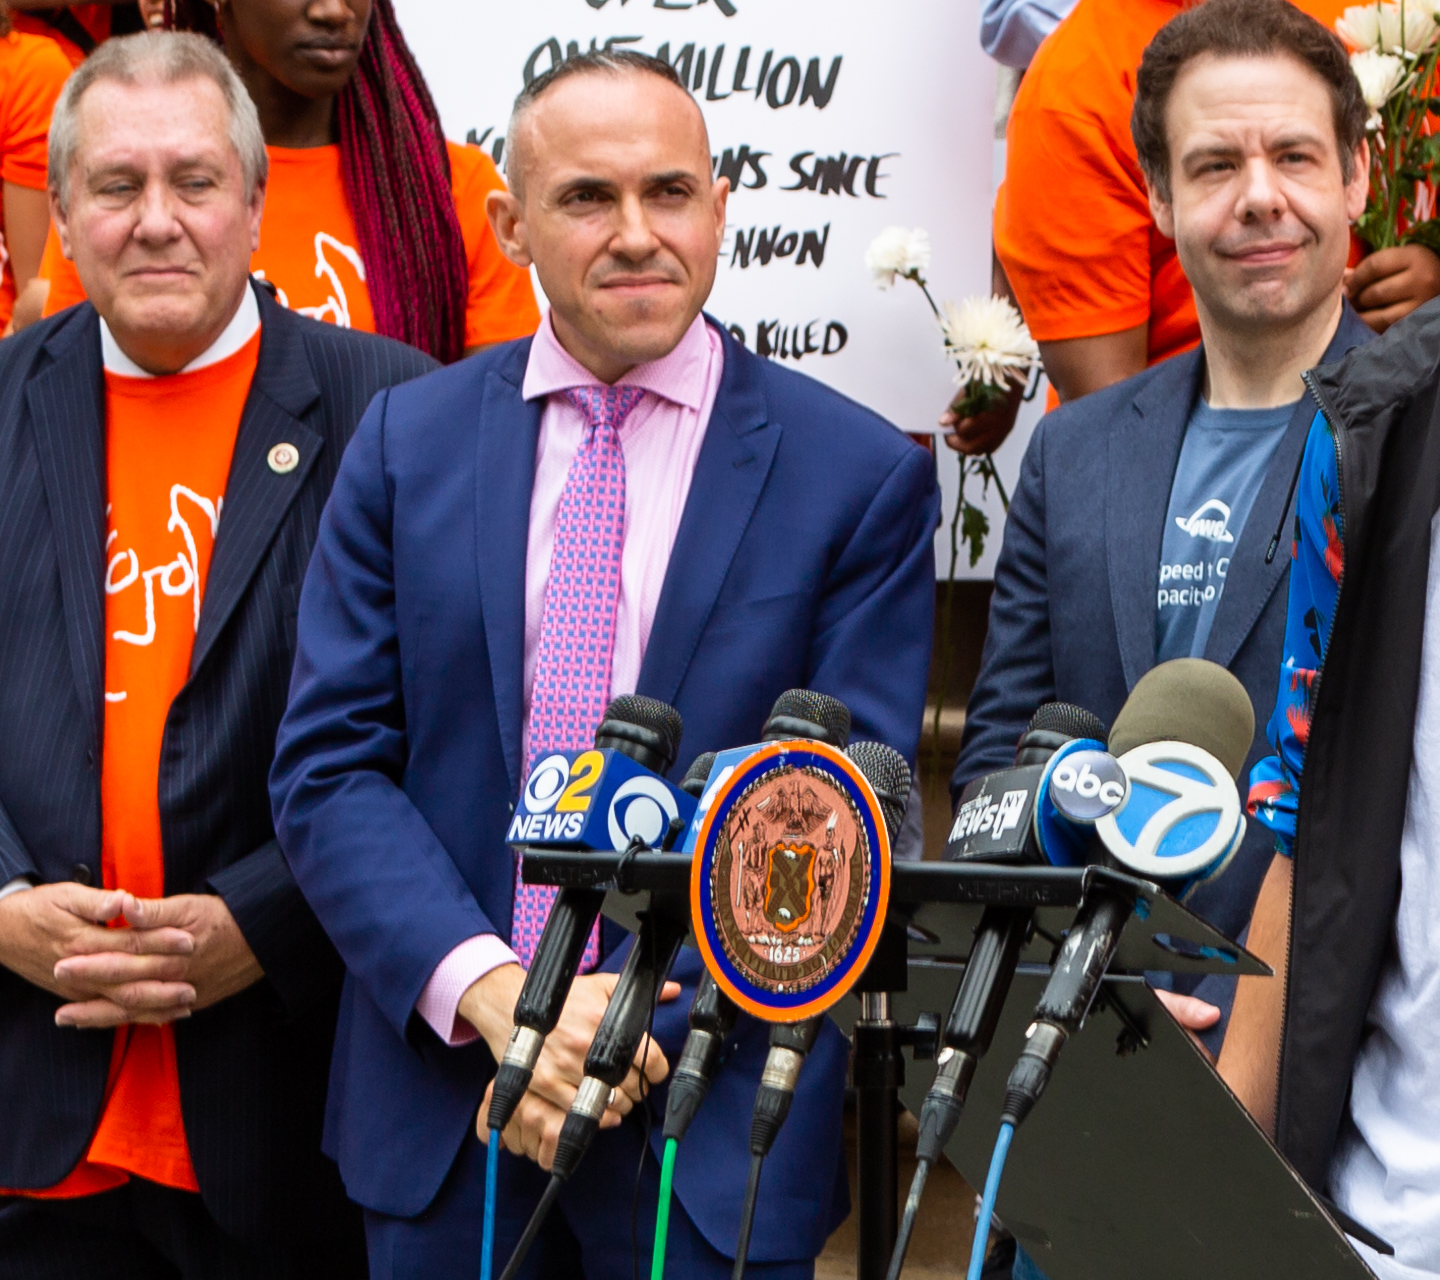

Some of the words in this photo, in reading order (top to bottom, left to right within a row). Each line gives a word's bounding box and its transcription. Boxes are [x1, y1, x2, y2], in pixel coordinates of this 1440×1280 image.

[659, 41, 844, 110] MILLION
[780, 150, 901, 199] SINCE
[756, 317, 849, 361] KILLED
[555, 750, 605, 813] 2
[1051, 763, 1126, 808] abc
[508, 812, 585, 841] NEWS
[948, 803, 999, 844] NEWS
[767, 946, 802, 963] 1625
